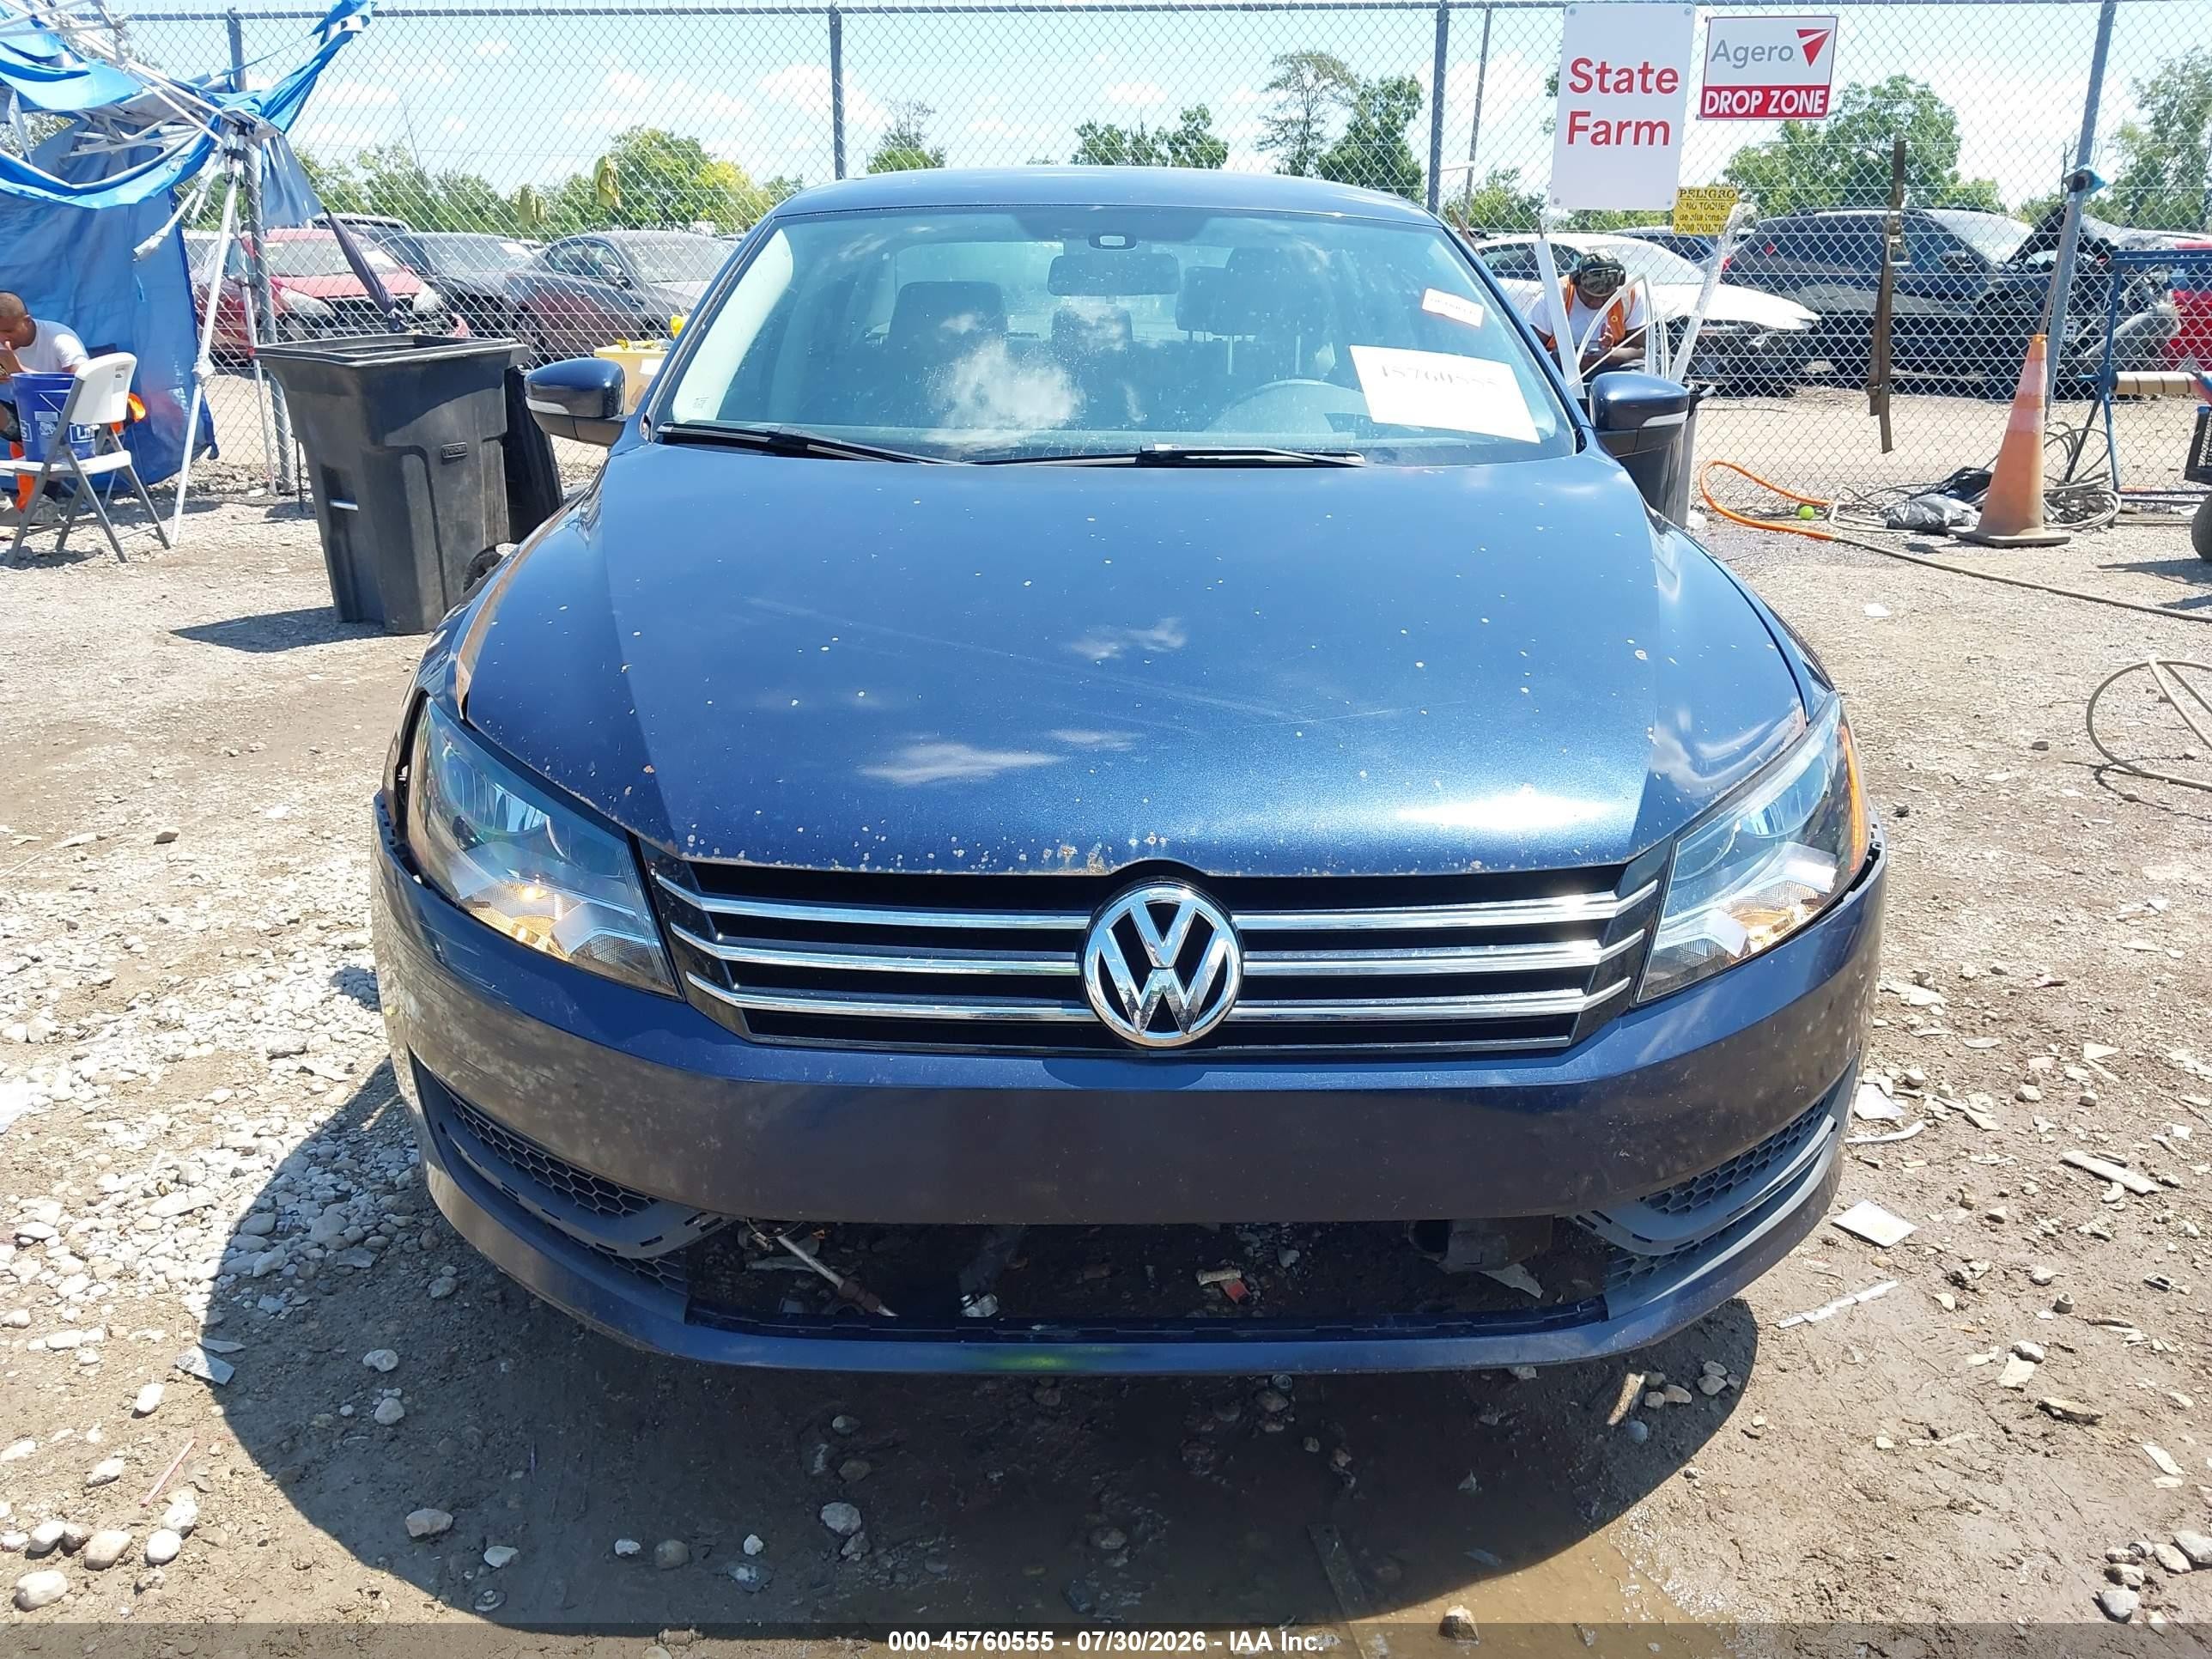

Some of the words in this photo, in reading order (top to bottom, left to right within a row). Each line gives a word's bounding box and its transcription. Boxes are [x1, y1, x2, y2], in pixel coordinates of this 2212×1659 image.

[1710, 40, 1795, 70] Agero
[1568, 57, 1680, 94] State
[1704, 89, 1763, 114] DROP
[1767, 89, 1826, 114] ZONE
[1566, 110, 1671, 146] Farm
[1679, 189, 1735, 199] PELIGRO
[1686, 202, 1697, 210] NO
[1699, 202, 1725, 210] TOQUE
